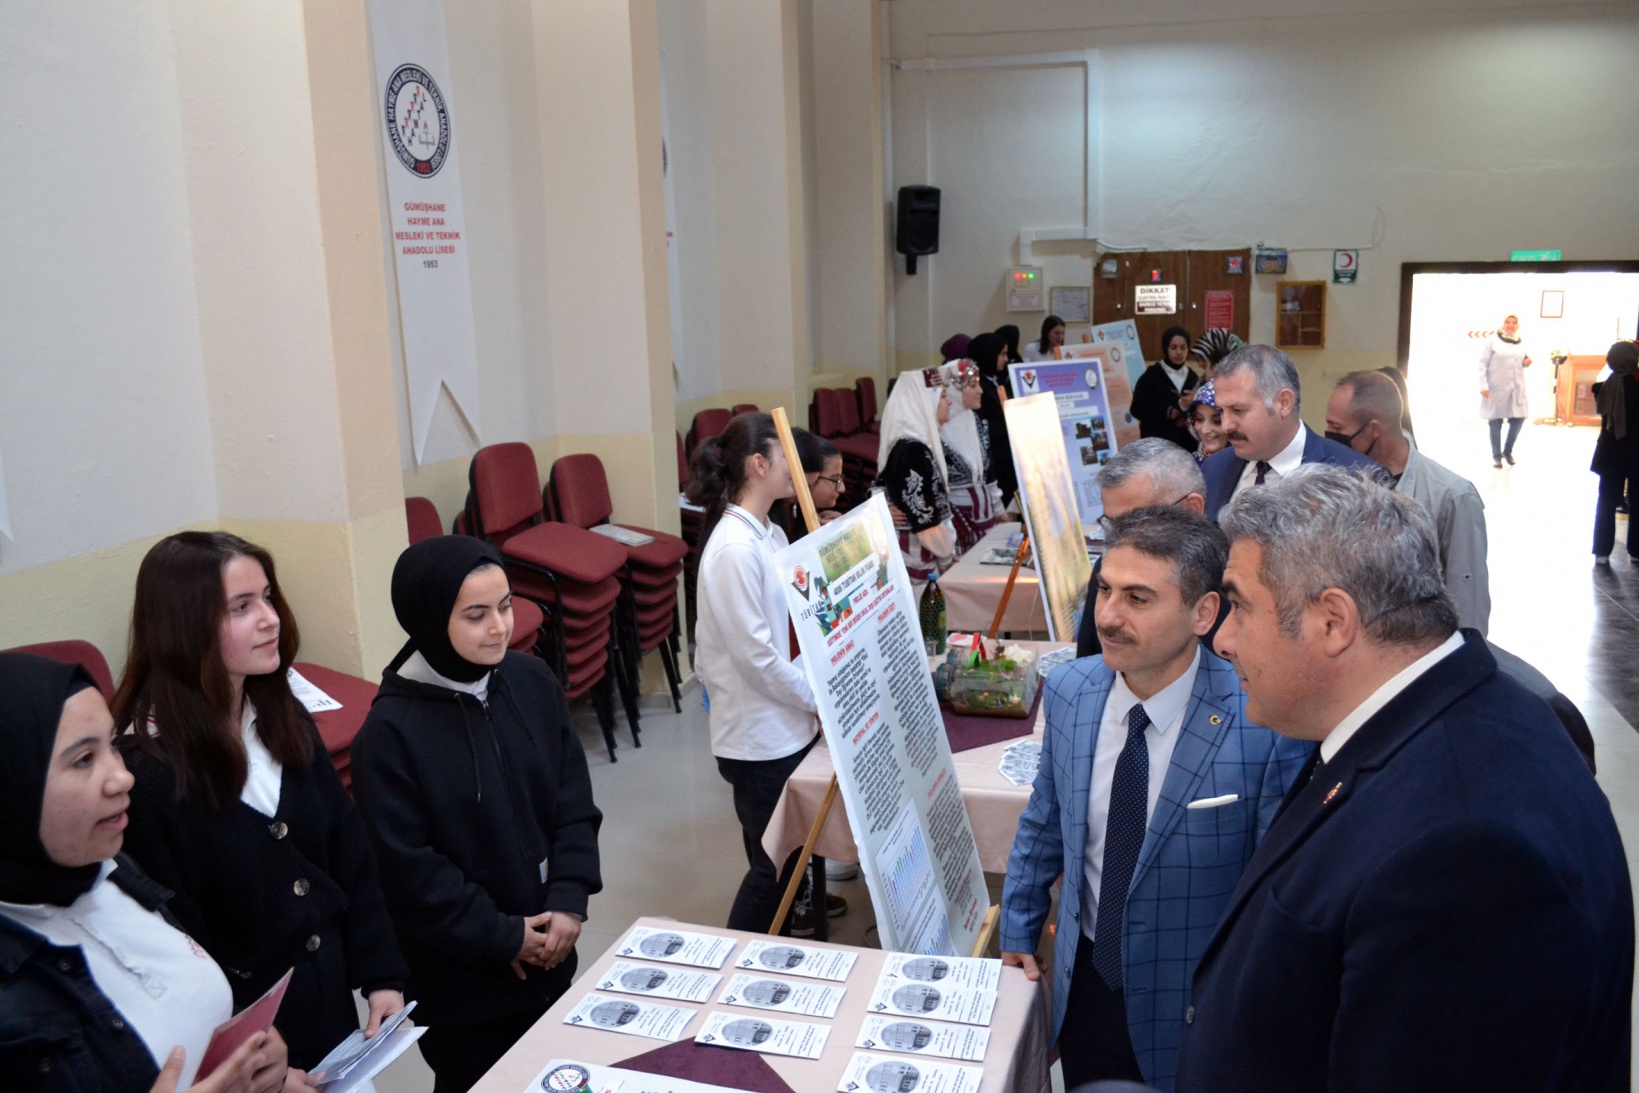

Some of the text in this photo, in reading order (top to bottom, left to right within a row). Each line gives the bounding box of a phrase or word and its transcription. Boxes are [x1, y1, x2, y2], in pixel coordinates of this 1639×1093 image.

[404, 201, 446, 213] GÜMÜŞHANE
[407, 217, 445, 226] HAYME ANA
[395, 230, 461, 240] MESLEKİ VE TEKNİK
[402, 244, 456, 255] ANADOLU LİSESİ
[423, 260, 438, 269] 1953
[1140, 286, 1169, 294] DİKKAT
